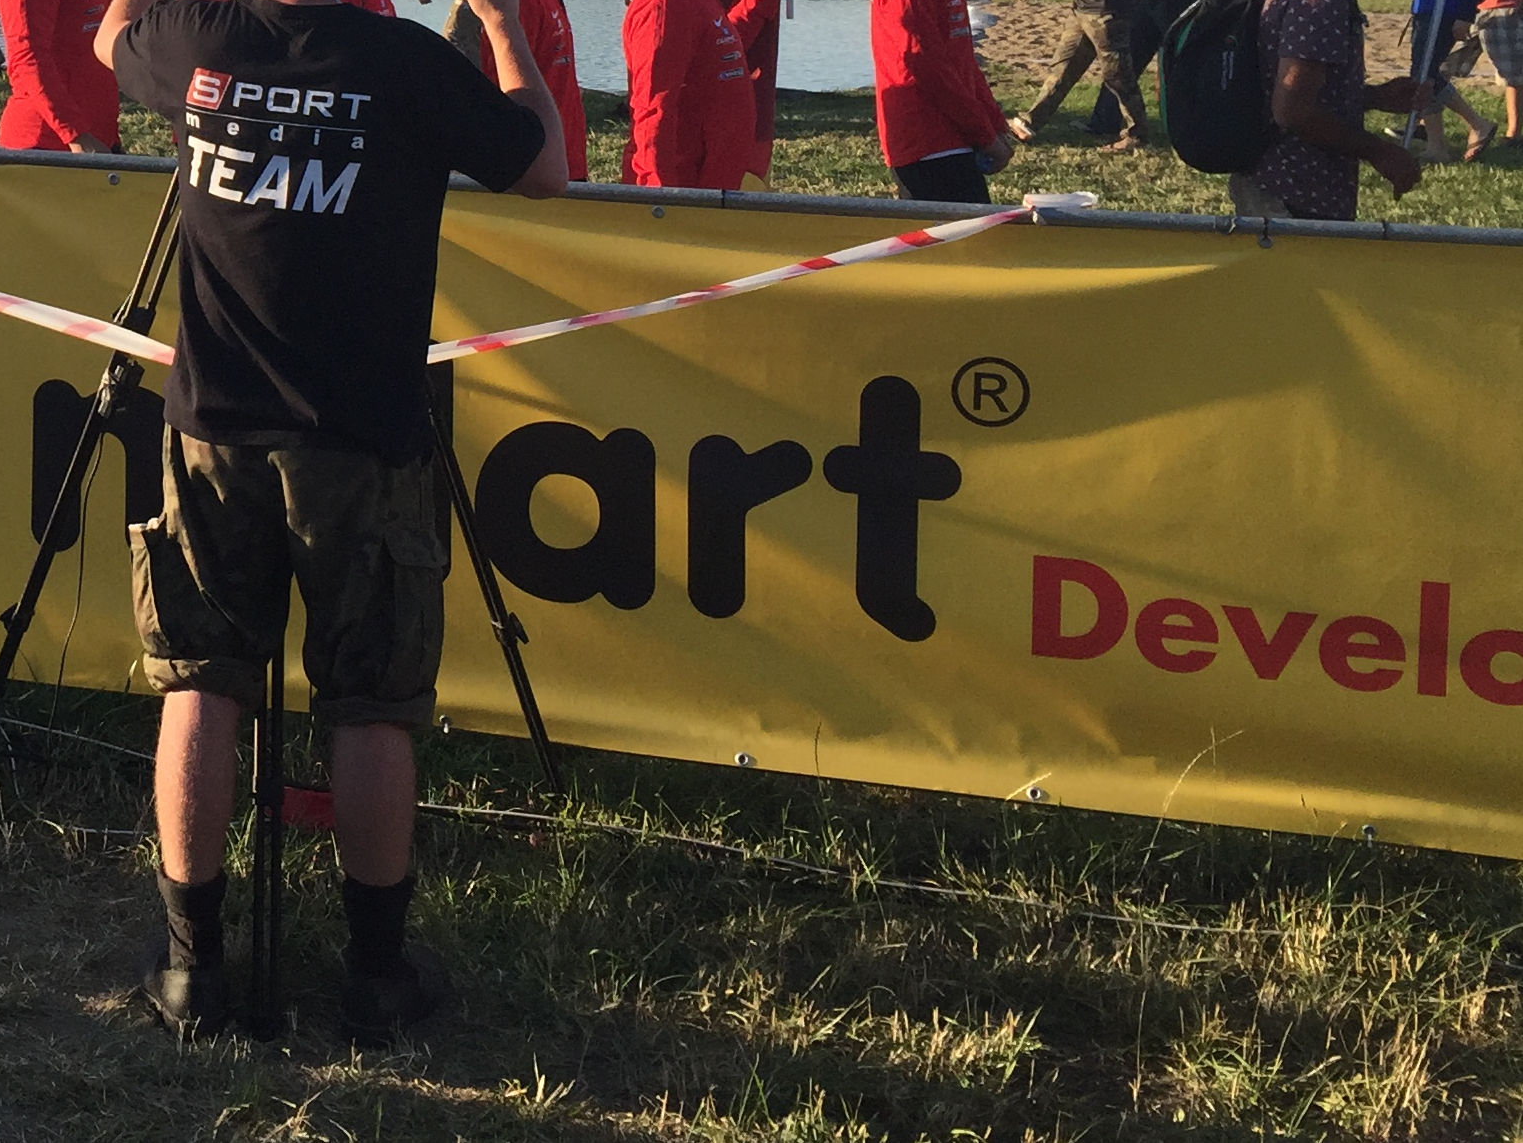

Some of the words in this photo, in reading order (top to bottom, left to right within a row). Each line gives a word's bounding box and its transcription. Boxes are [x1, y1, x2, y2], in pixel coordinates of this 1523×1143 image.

[192, 74, 372, 121] SPORT
[185, 111, 364, 150] media
[187, 135, 362, 215] TEAM
